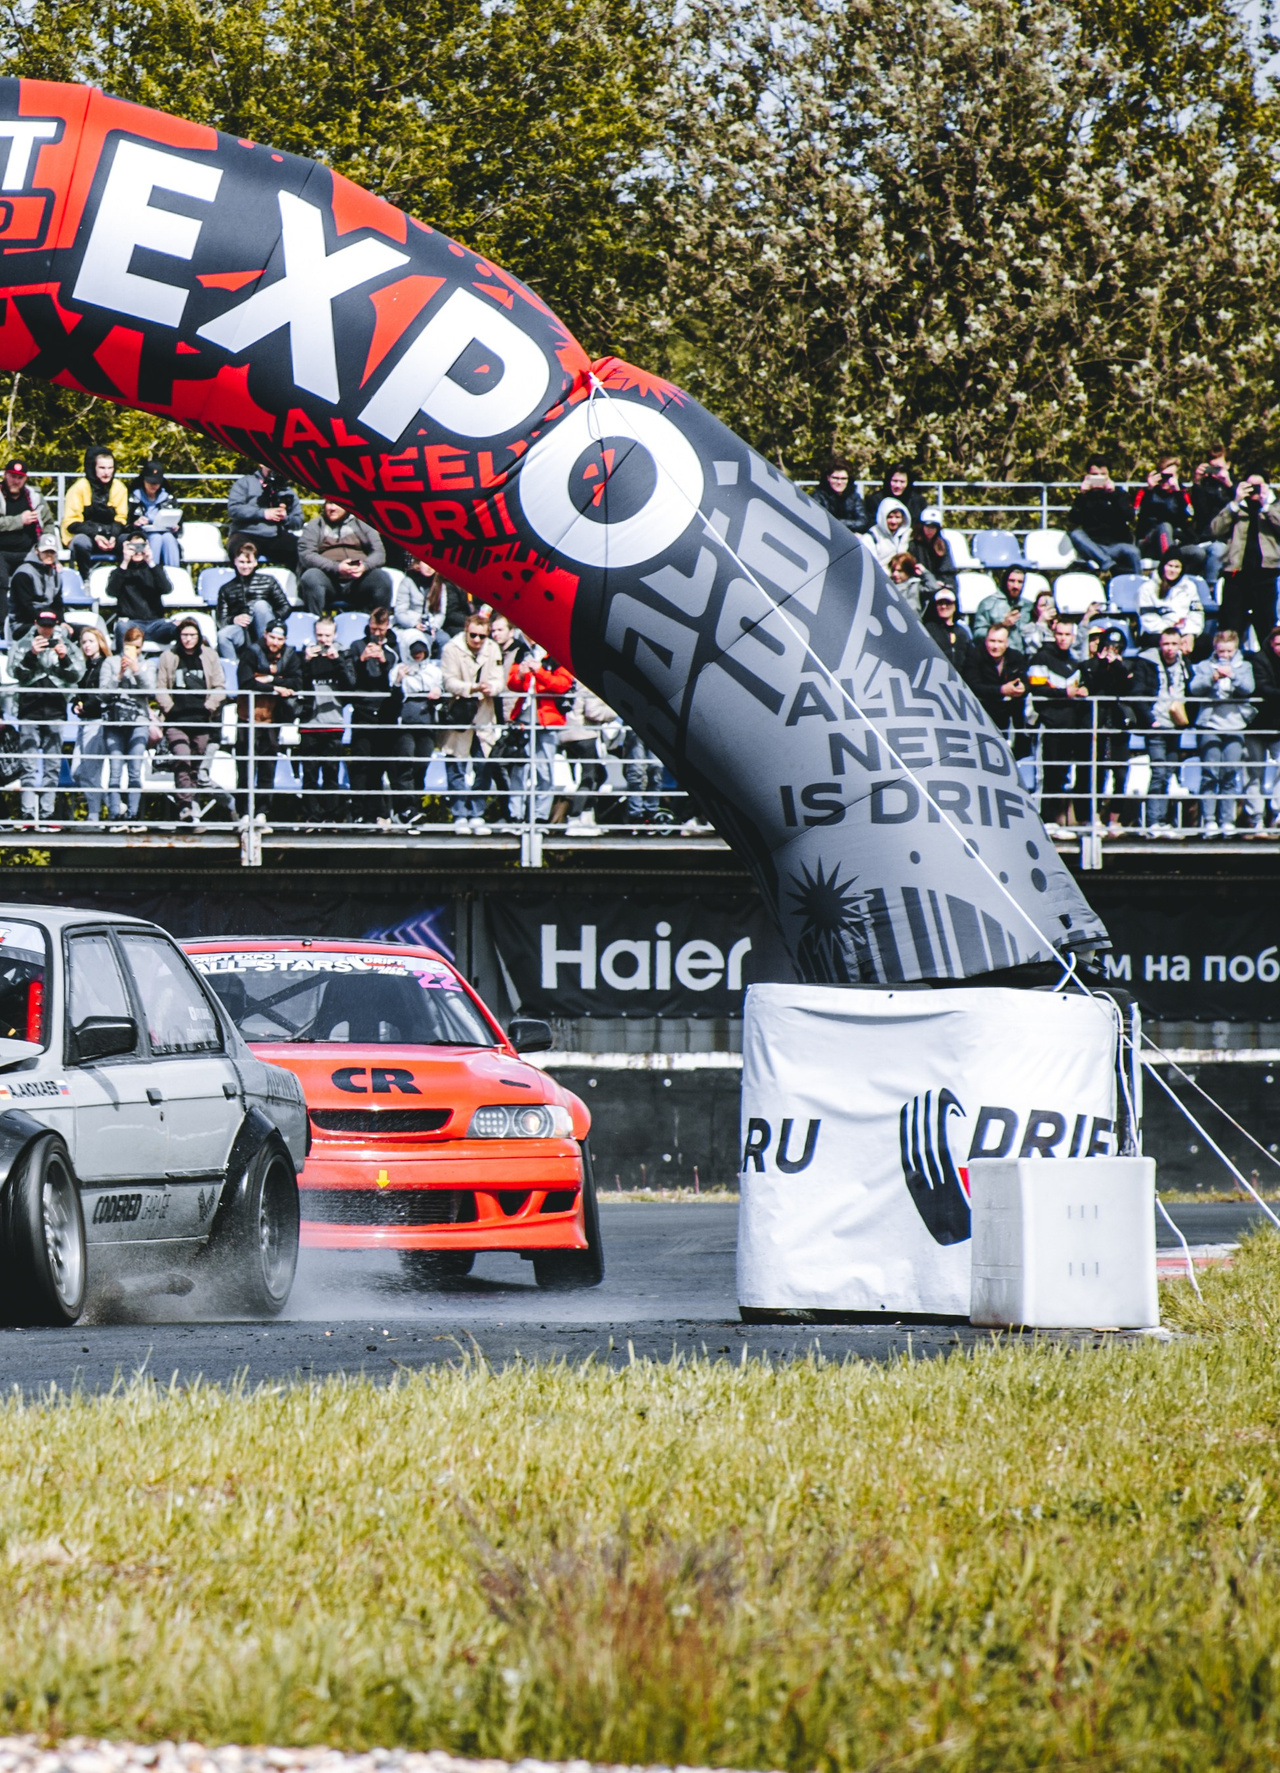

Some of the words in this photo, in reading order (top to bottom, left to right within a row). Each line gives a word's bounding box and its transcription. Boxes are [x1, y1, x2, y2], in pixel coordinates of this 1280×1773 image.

[72, 138, 705, 569] EXPO
[828, 727, 1012, 777] NEED
[780, 782, 847, 828] IS
[870, 780, 1040, 829] DRIF
[255, 959, 353, 974] STARS
[541, 921, 752, 991] Haier
[1144, 954, 1190, 982] на
[412, 970, 464, 992] 22
[331, 1067, 423, 1095] CR
[743, 1117, 822, 1175] RU
